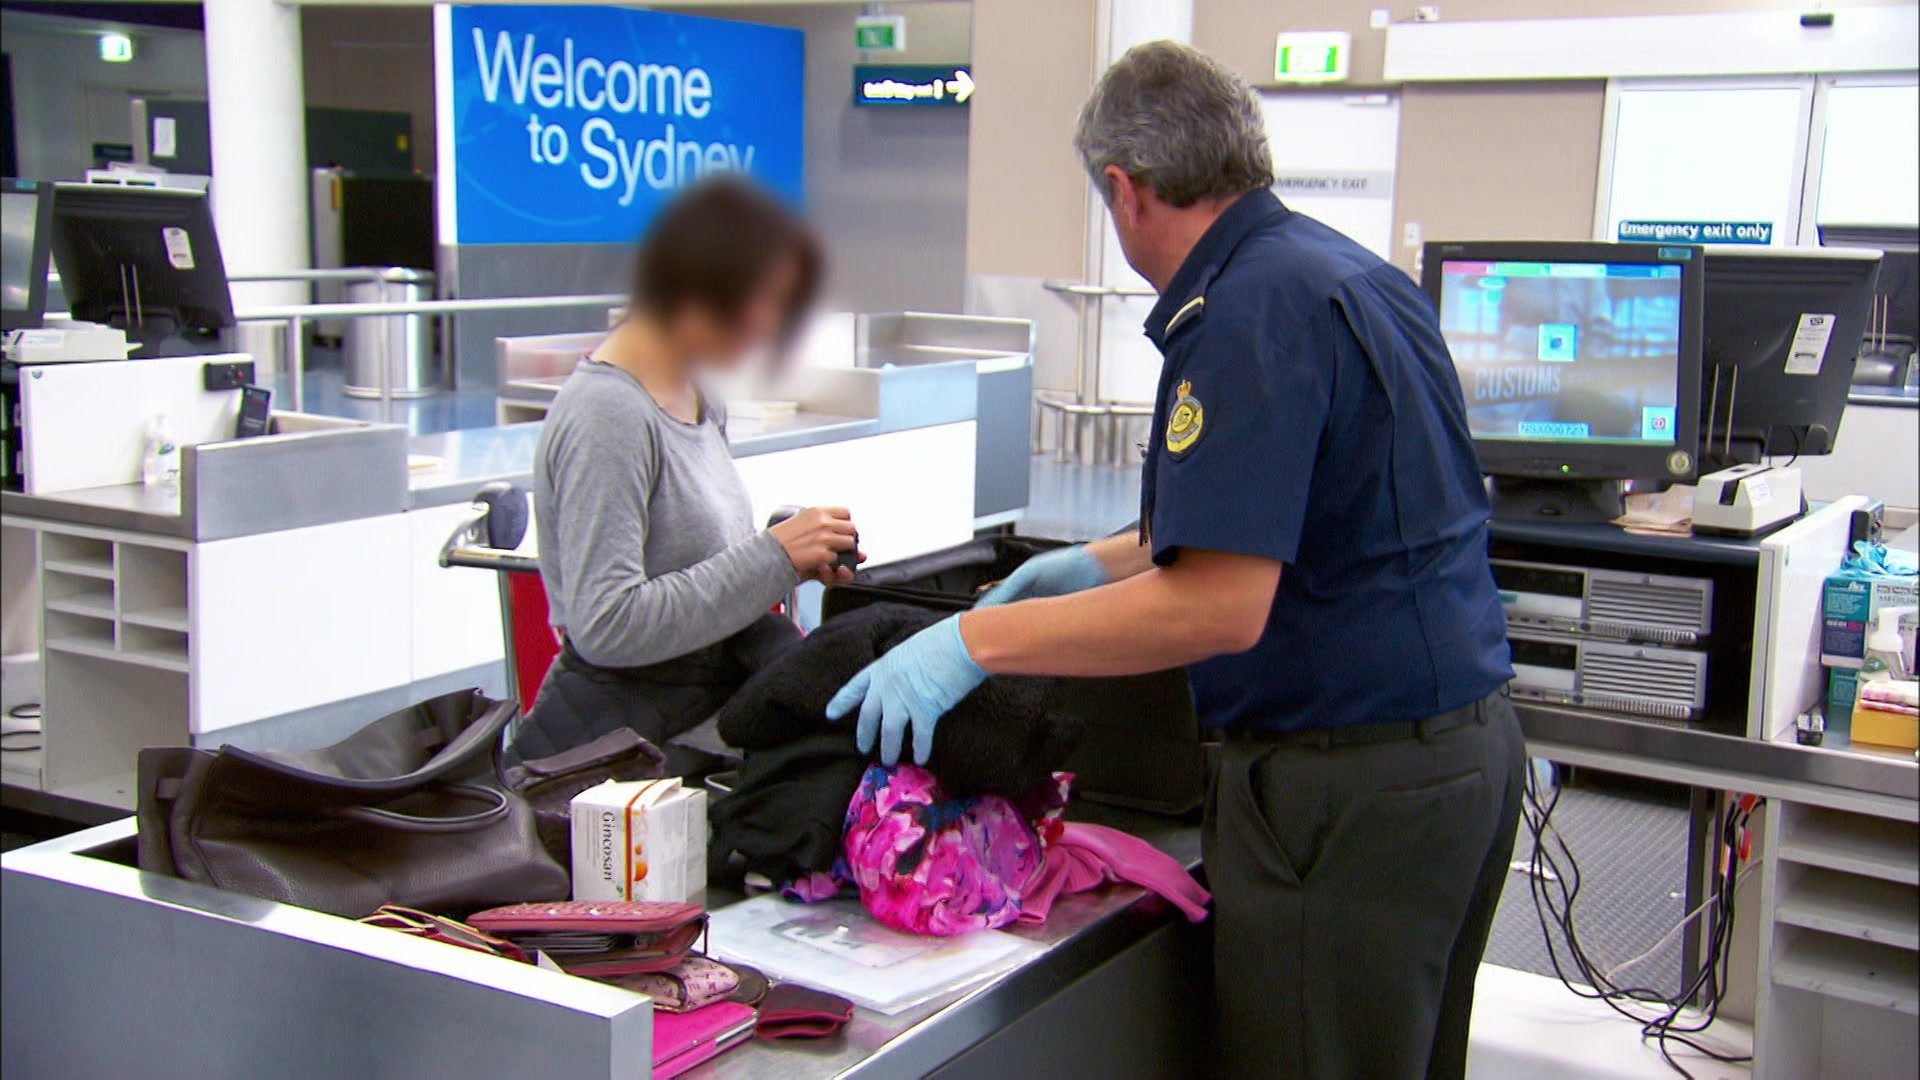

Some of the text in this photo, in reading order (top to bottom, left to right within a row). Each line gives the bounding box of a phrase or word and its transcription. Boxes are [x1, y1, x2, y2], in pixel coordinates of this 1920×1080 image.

[472, 27, 712, 118] Welcome
[526, 113, 755, 206] to Sydney
[1274, 177, 1367, 190] MERGENCY EXIT
[1620, 222, 1770, 242] Emergency exit only
[1475, 364, 1562, 401] CUSTOMS
[602, 811, 615, 881] Gincosan
